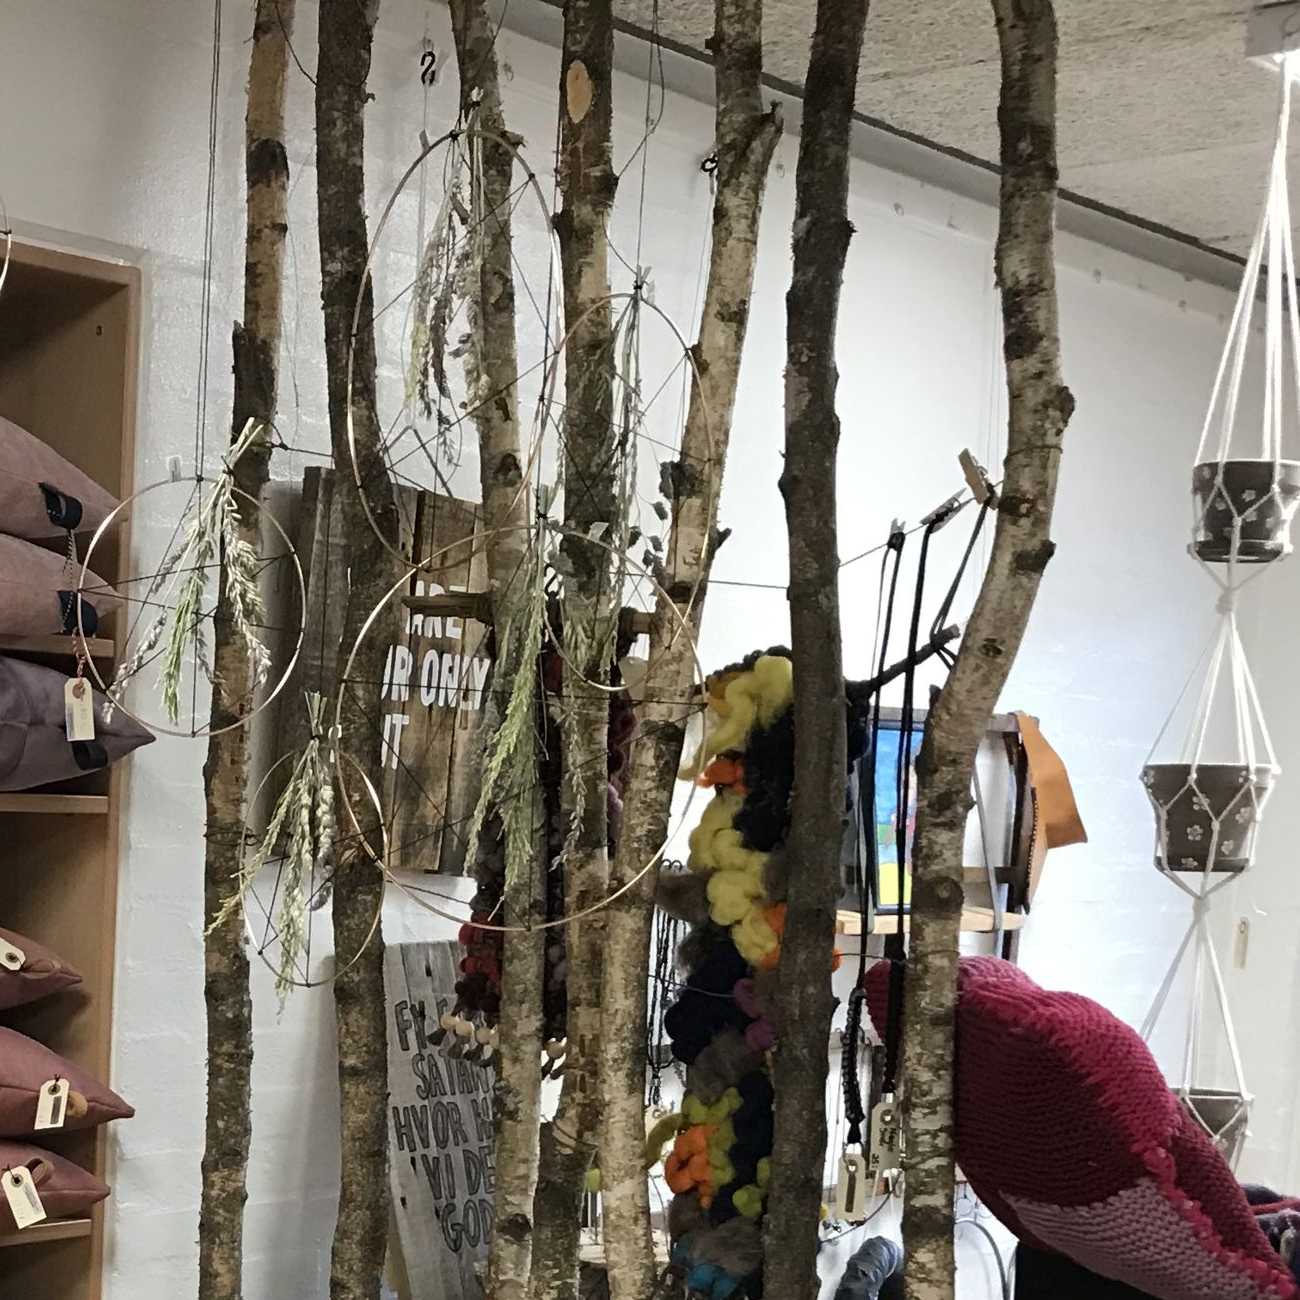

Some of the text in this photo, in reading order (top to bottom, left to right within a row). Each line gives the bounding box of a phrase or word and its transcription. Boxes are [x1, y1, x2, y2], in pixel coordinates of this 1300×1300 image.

[421, 649, 490, 710] ONLY
[392, 1101, 469, 1152] HVOR
[421, 1154, 456, 1200] VI
